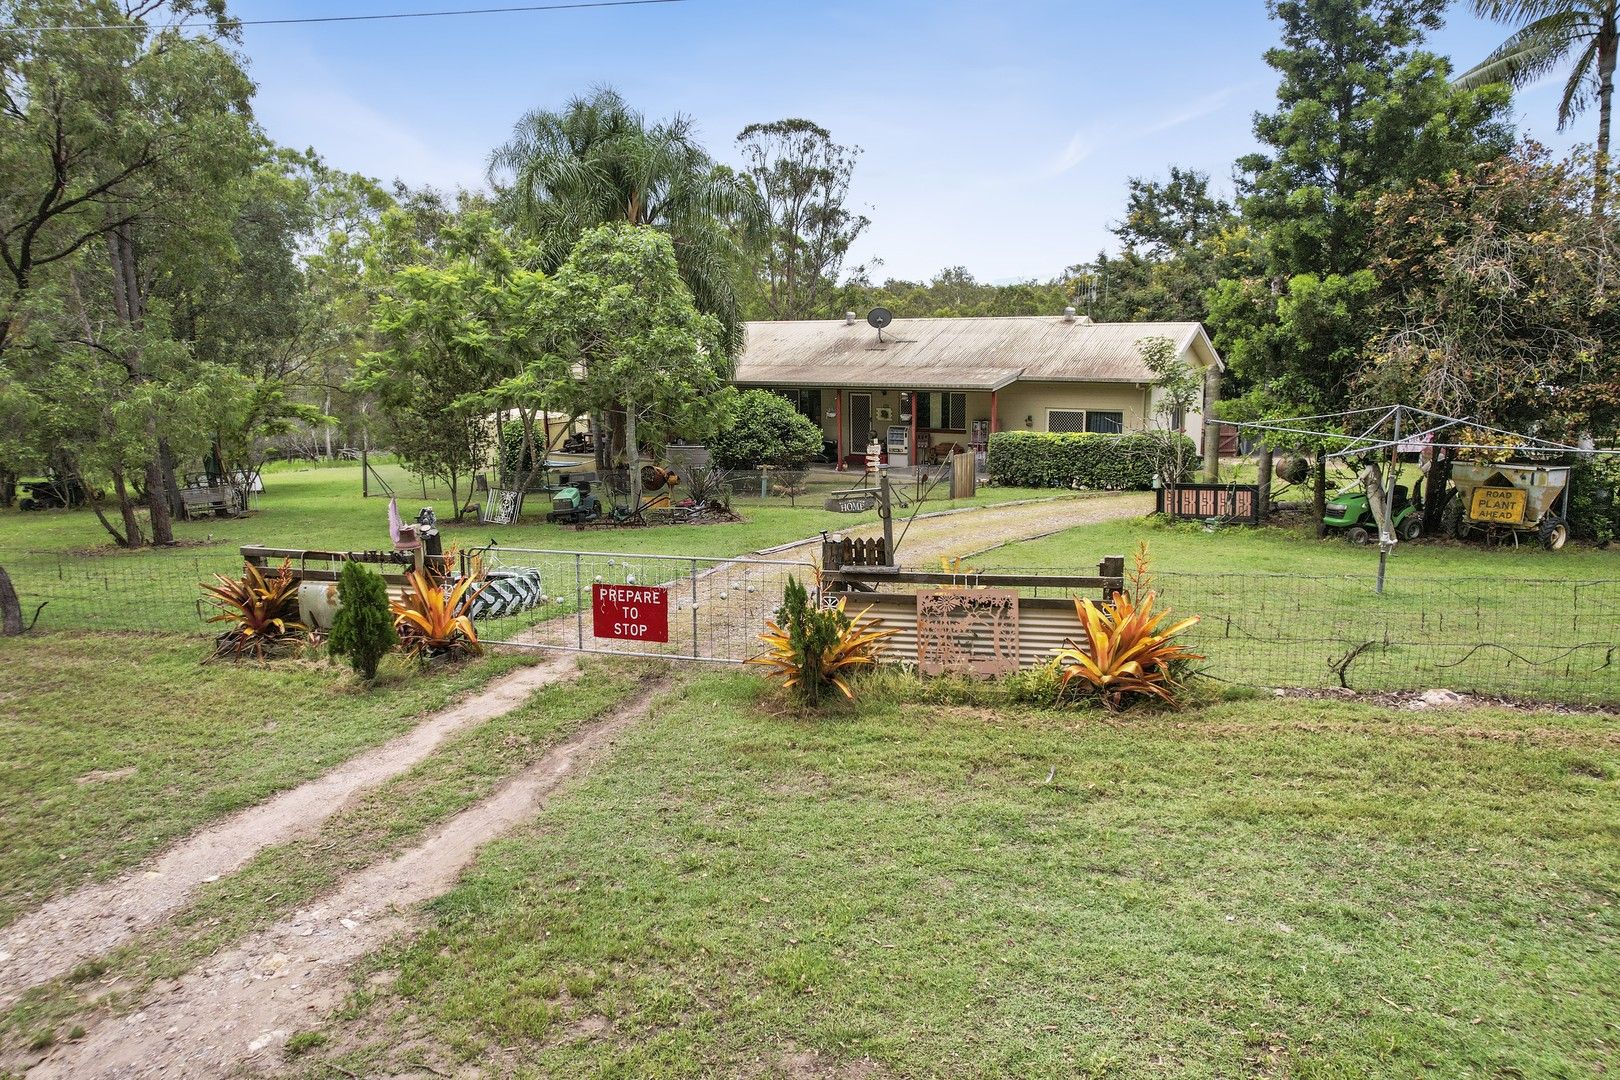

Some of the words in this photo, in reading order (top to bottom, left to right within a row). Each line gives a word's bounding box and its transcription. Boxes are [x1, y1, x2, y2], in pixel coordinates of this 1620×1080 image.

[1486, 490, 1512, 499] ROAD
[840, 501, 865, 511] HOME
[1479, 499, 1516, 510] PLANT
[1479, 510, 1512, 519] AHEAD
[599, 588, 661, 605] PREPARE
[622, 606, 639, 620] TO
[614, 622, 648, 637] STOP
